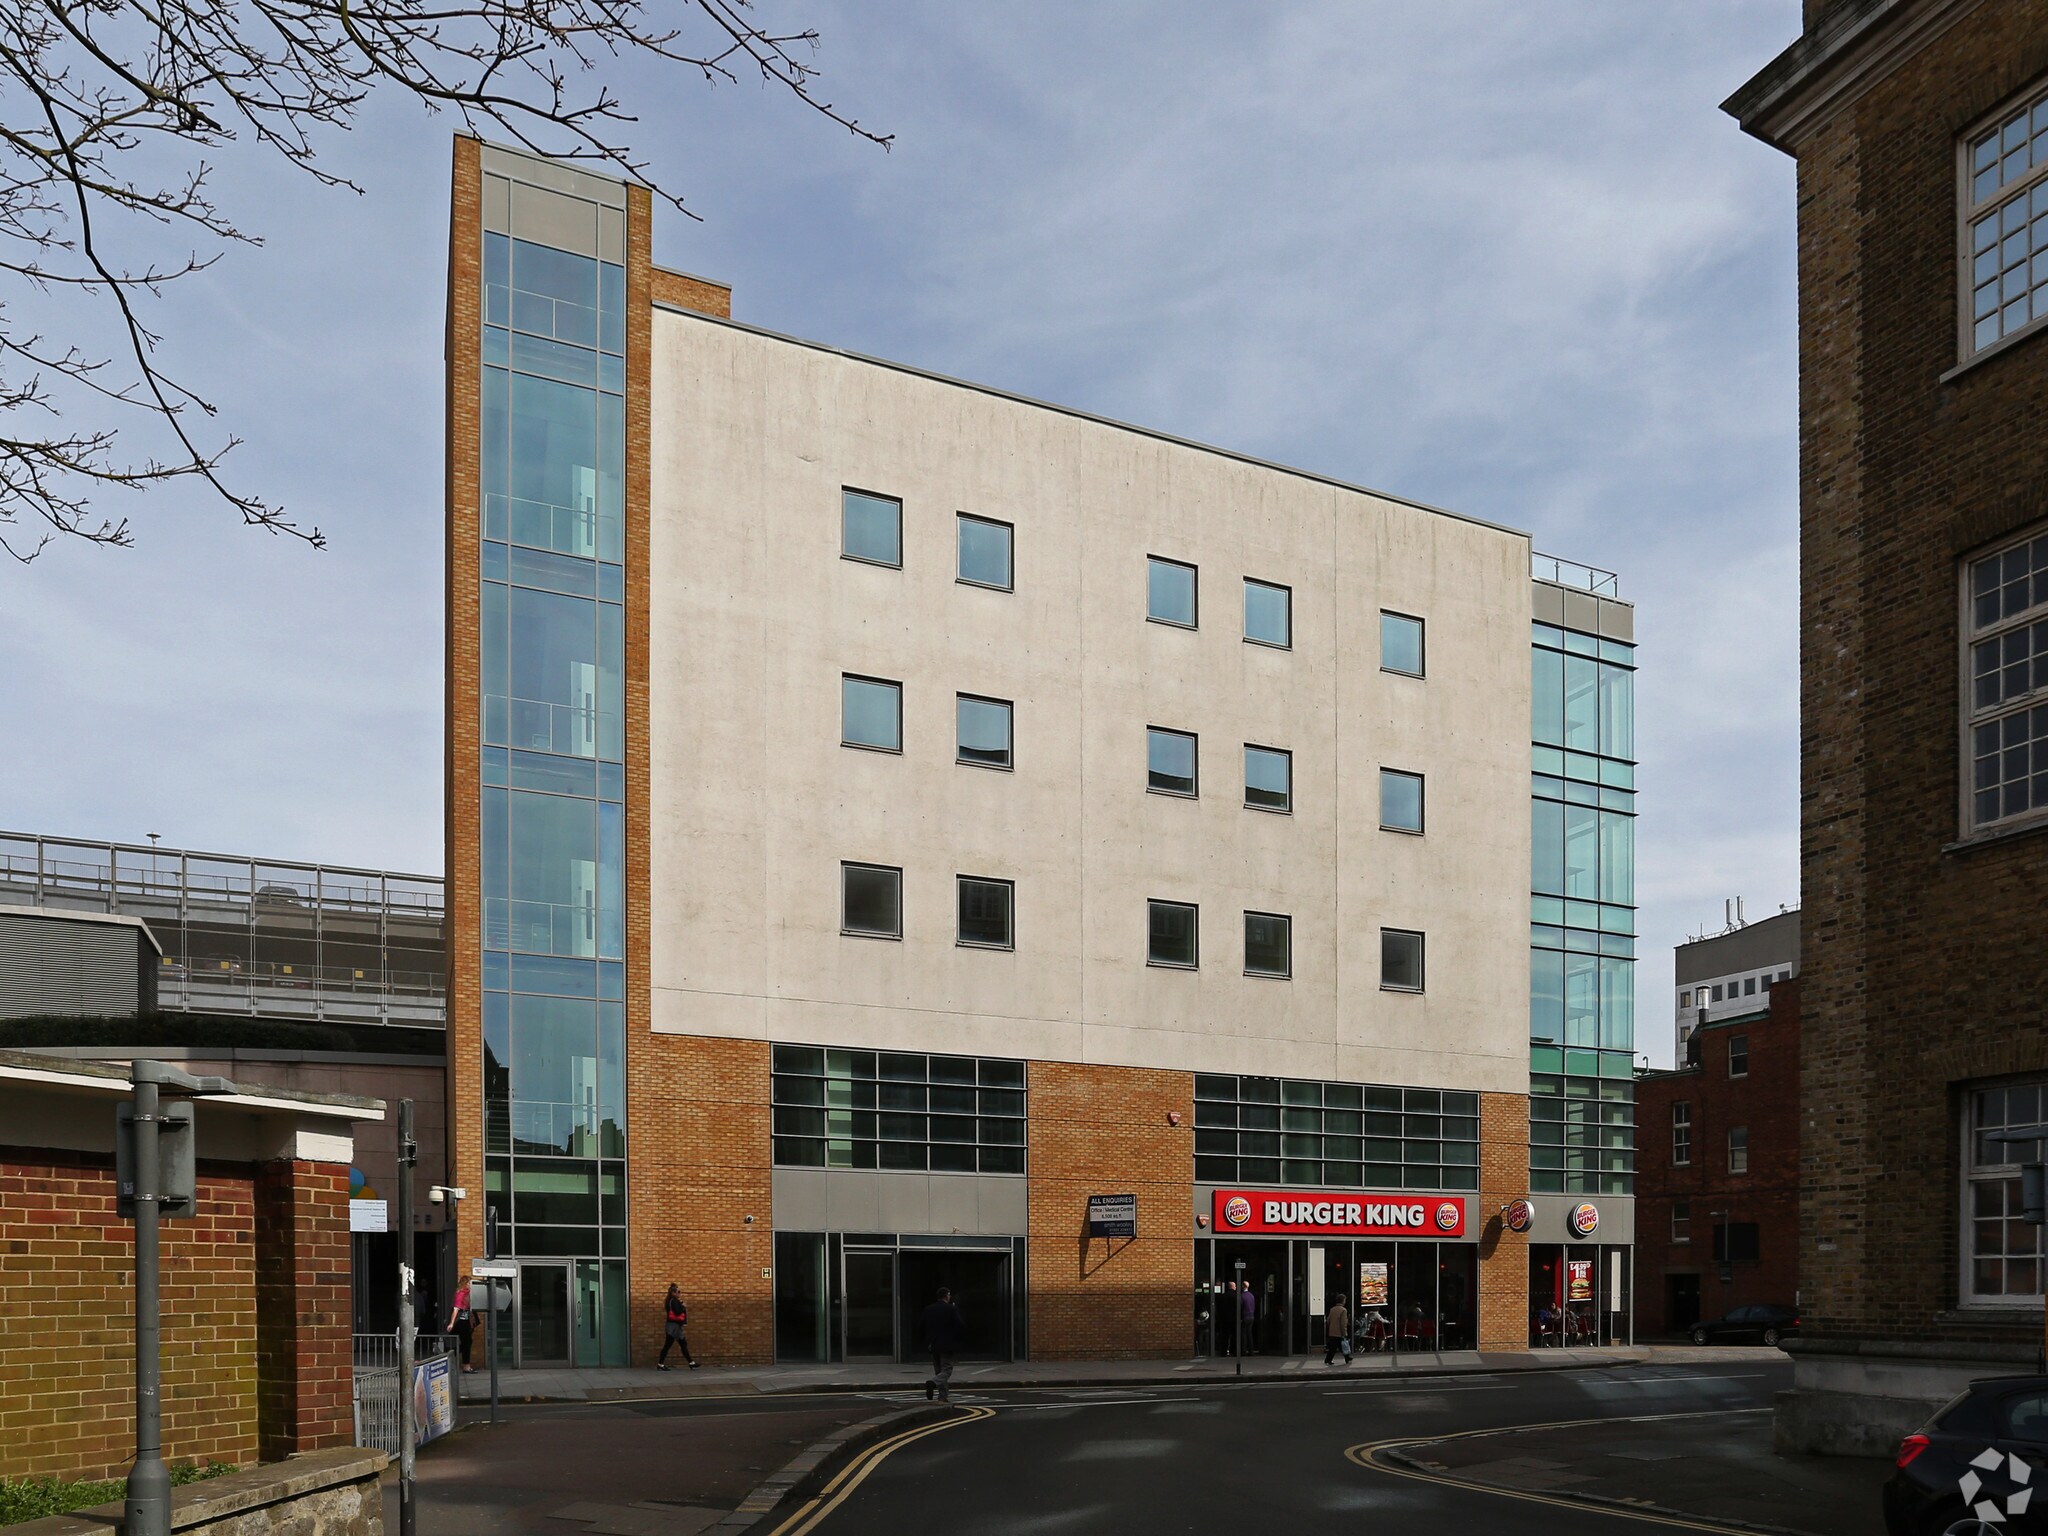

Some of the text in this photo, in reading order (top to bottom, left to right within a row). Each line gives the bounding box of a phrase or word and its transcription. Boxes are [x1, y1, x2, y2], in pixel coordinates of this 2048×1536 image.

[1229, 1203, 1248, 1211] BURGER
[1510, 1204, 1526, 1216] BURGER
[1229, 1208, 1248, 1218] KING
[1264, 1201, 1425, 1226] BURGER KING
[1439, 1213, 1457, 1221] KING
[1510, 1211, 1527, 1223] KING
[1577, 1208, 1595, 1219] BURGER
[1578, 1214, 1596, 1227] KING
